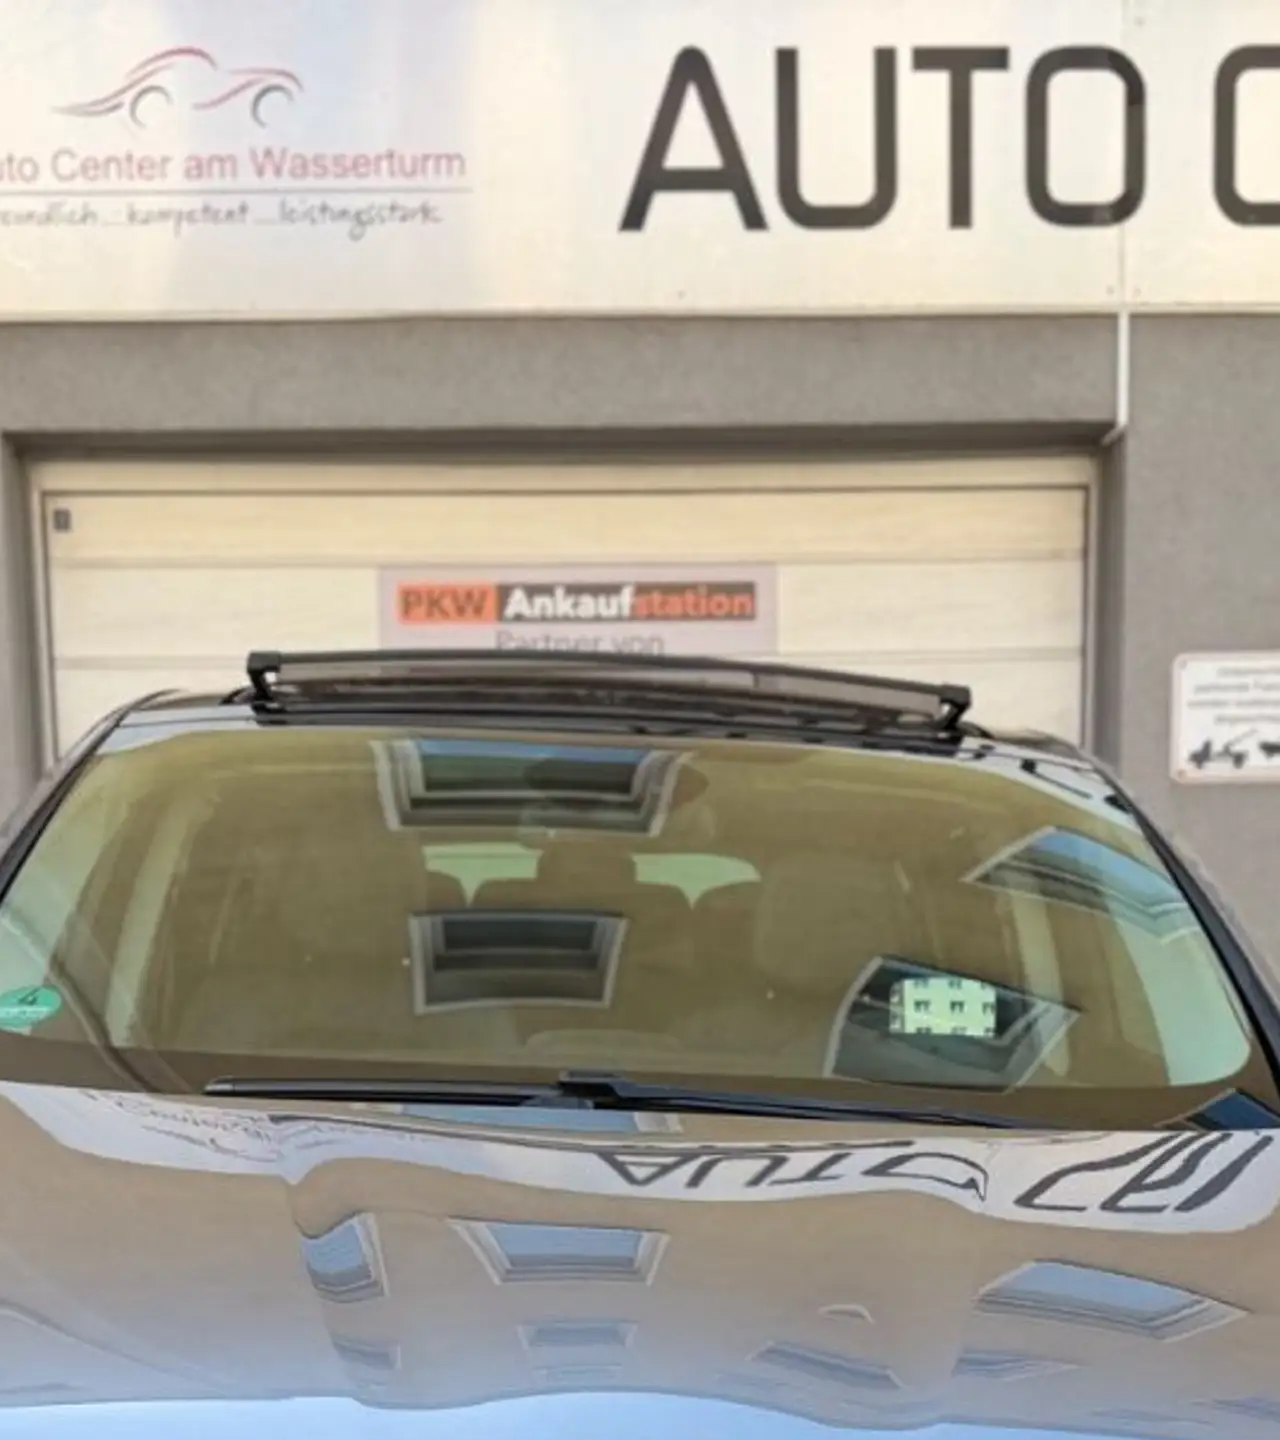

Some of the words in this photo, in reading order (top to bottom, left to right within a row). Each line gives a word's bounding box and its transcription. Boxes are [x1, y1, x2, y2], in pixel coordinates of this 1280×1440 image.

[617, 45, 1147, 232] AUTO
[51, 147, 173, 183] Center
[183, 153, 238, 182] am
[248, 146, 467, 180] Wasserturm
[401, 588, 489, 620] PKW
[496, 630, 603, 652] Partner
